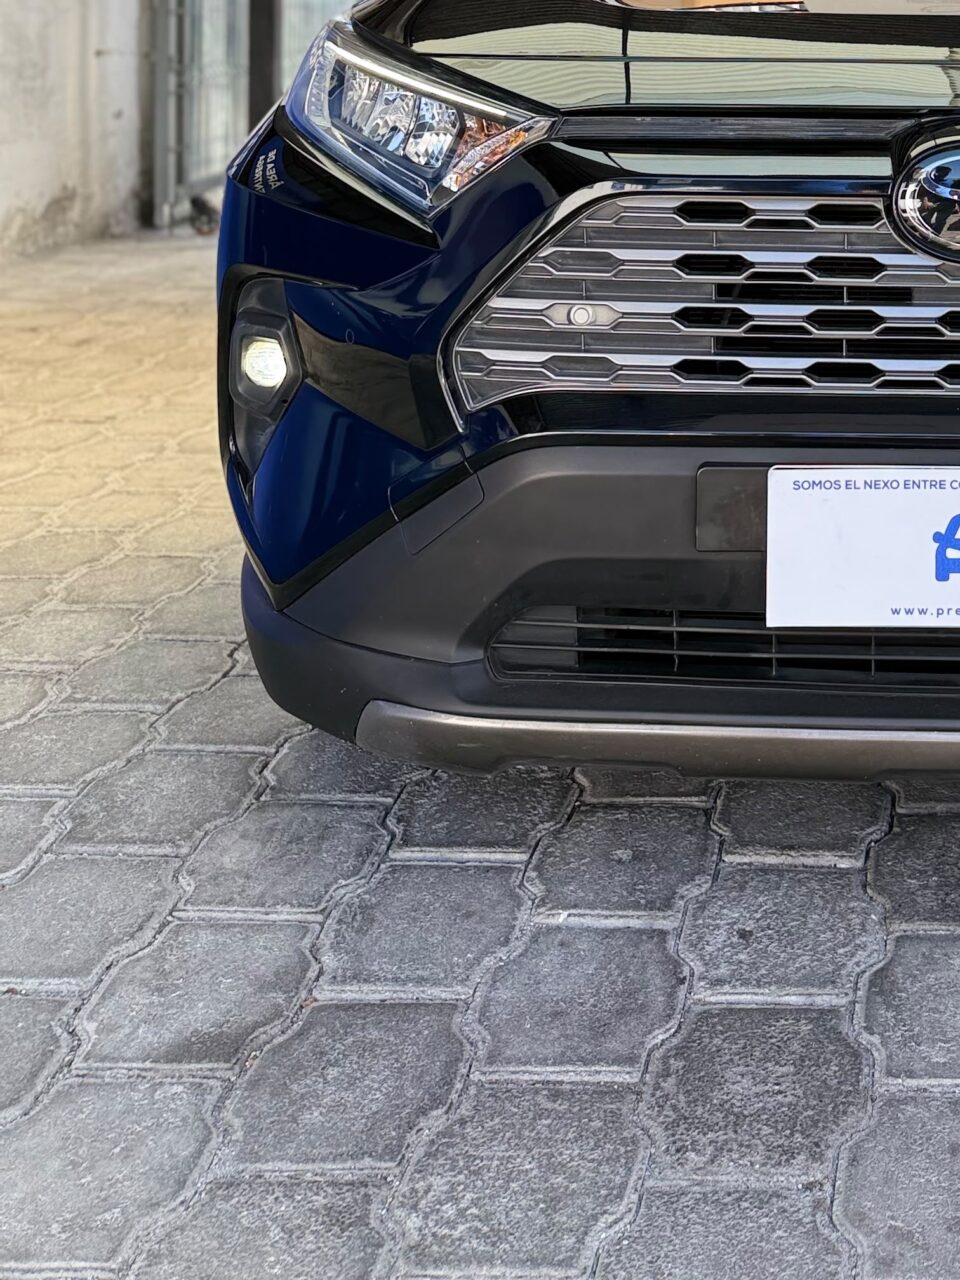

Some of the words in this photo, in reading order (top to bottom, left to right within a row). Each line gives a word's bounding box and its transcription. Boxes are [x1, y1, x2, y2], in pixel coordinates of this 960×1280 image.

[792, 479, 842, 491] SOMOS
[844, 479, 861, 490] EL
[863, 479, 900, 490] NEXO
[903, 479, 947, 490] ENTRE
